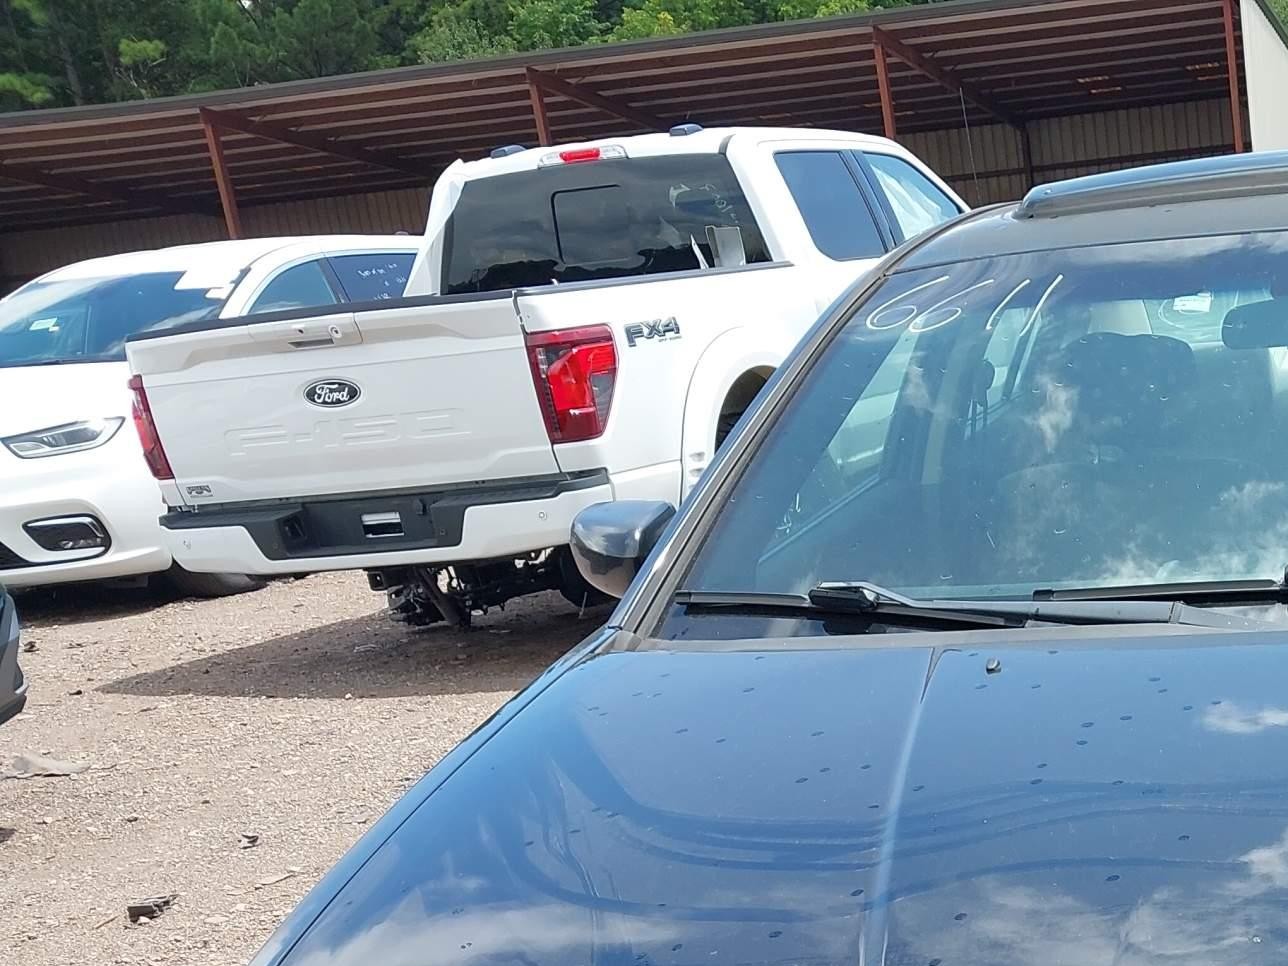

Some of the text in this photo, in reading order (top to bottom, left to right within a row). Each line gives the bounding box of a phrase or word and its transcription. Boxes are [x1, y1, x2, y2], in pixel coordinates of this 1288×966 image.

[866, 274, 1064, 336] 6611
[624, 316, 680, 347] FX4
[314, 384, 350, 403] Ford
[223, 407, 472, 457] F-150
